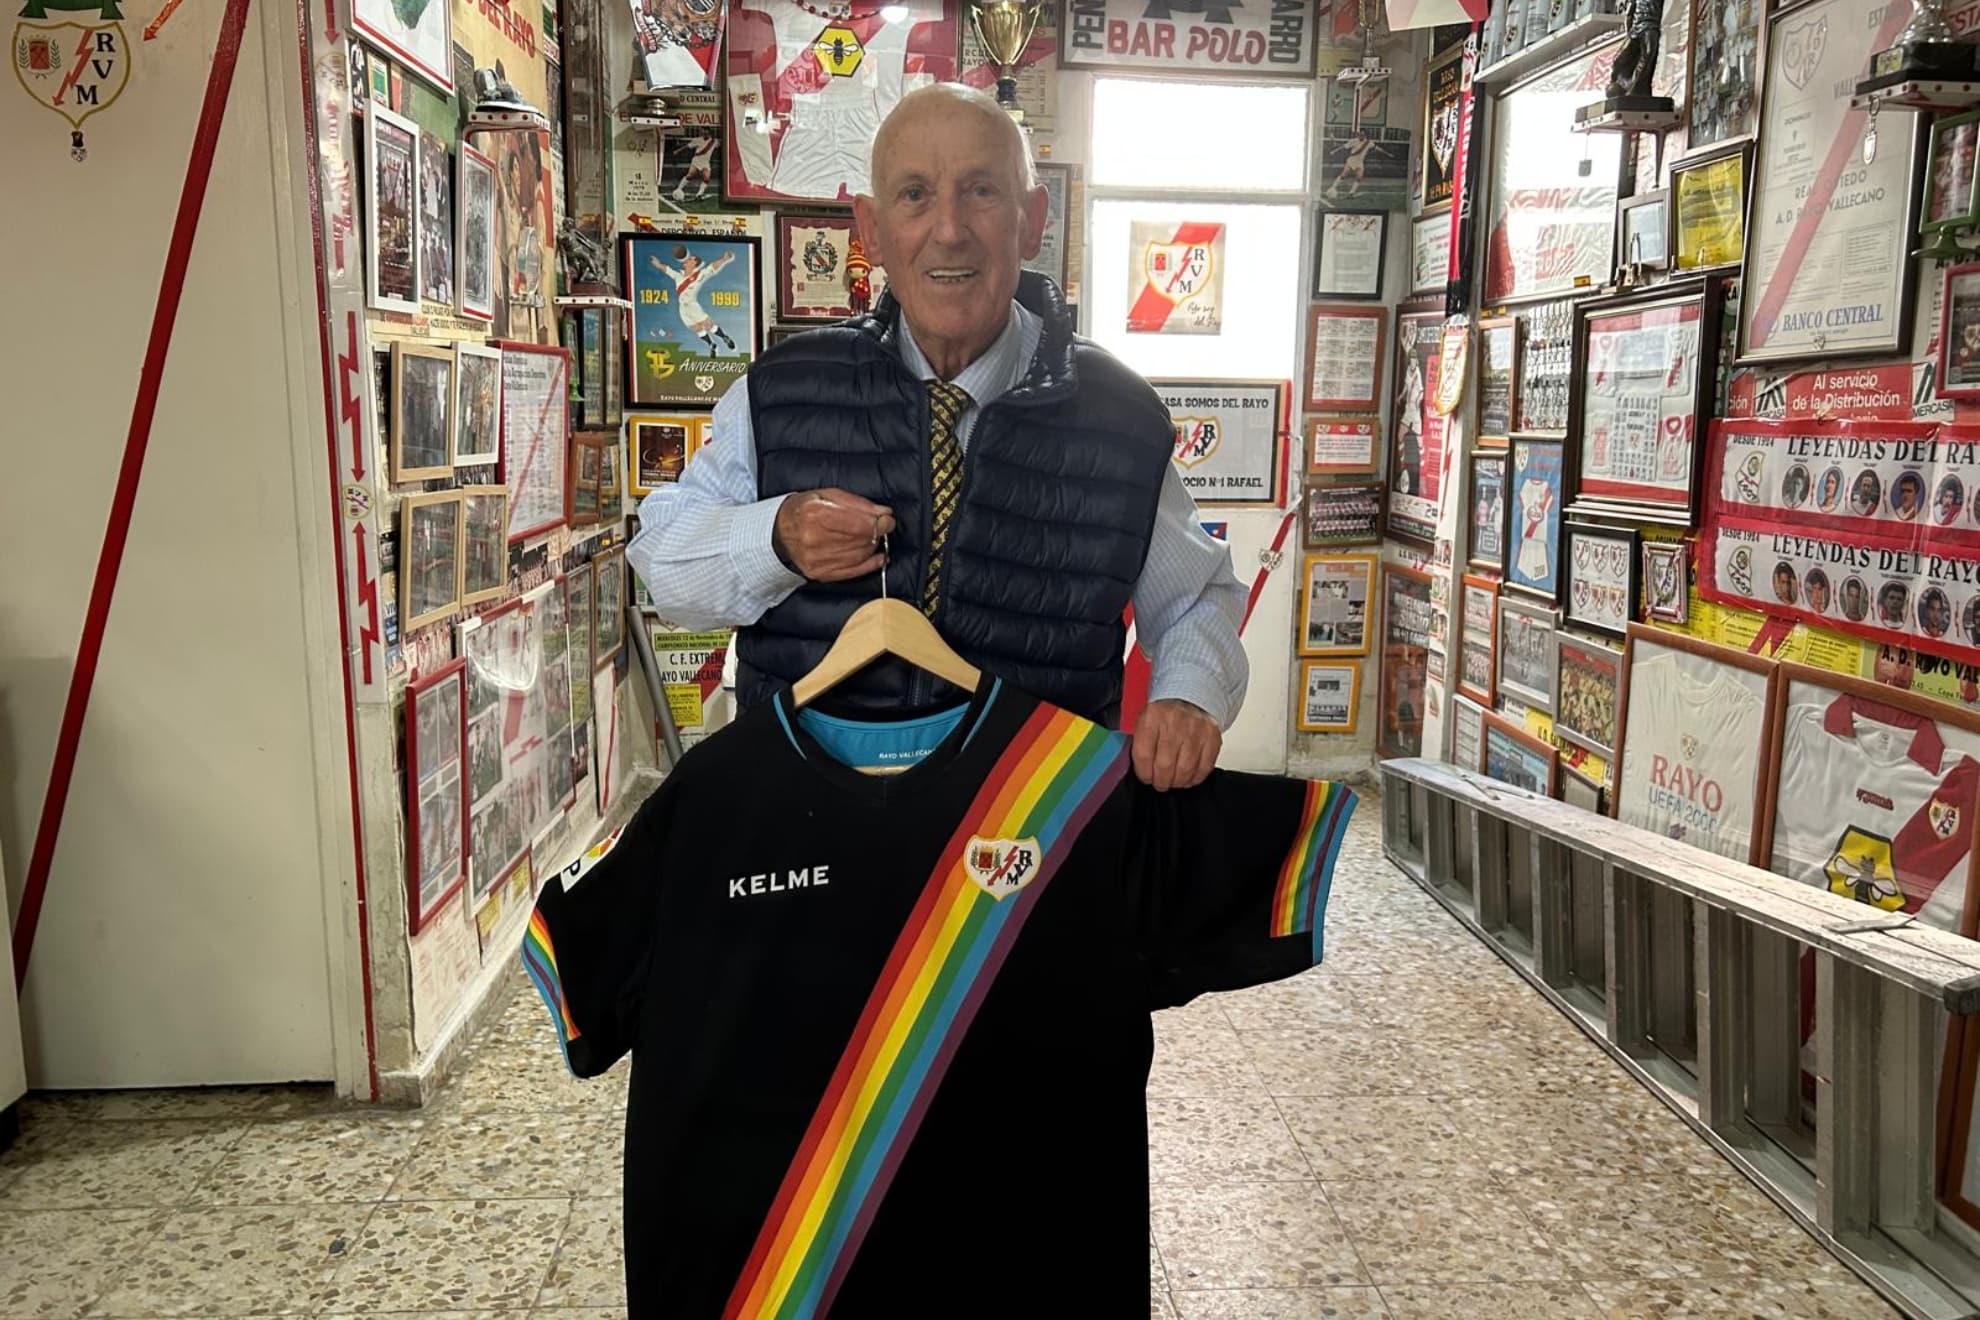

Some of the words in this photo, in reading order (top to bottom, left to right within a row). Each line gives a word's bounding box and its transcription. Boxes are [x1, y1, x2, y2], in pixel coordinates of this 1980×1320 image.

[96, 32, 116, 52] R
[1107, 19, 1176, 58] BAR
[1186, 25, 1266, 65] POLO
[91, 59, 114, 79] V
[76, 84, 99, 105] M
[1828, 187, 1886, 211] VALLECANO
[640, 288, 669, 305] 1924
[1783, 311, 1823, 331] BANCO
[1826, 304, 1884, 327] CENTRAL
[1813, 374, 1826, 390] Al
[1829, 373, 1878, 389] servicio
[1185, 398, 1219, 408] SOMOS
[1222, 398, 1240, 409] DEL
[1242, 398, 1269, 409] RAYO
[1793, 396, 1807, 410] de
[1810, 394, 1820, 409] la
[1825, 391, 1900, 408] Distribución
[1787, 435, 1887, 461] LEYENDAS
[1893, 440, 1939, 464] DEL
[1946, 442, 1980, 465] RA
[1227, 477, 1264, 488] RAFAEL
[1772, 534, 1871, 568] LEYENDAS
[1878, 549, 1923, 576] DEL
[670, 653, 677, 665] C.
[680, 652, 688, 665] F.
[1915, 652, 1950, 676] RYO
[1650, 754, 1723, 813] RAYO
[1649, 785, 1682, 818] UEFA
[1018, 849, 1033, 866] R
[729, 865, 829, 898] KELME
[1006, 872, 1019, 886] M
